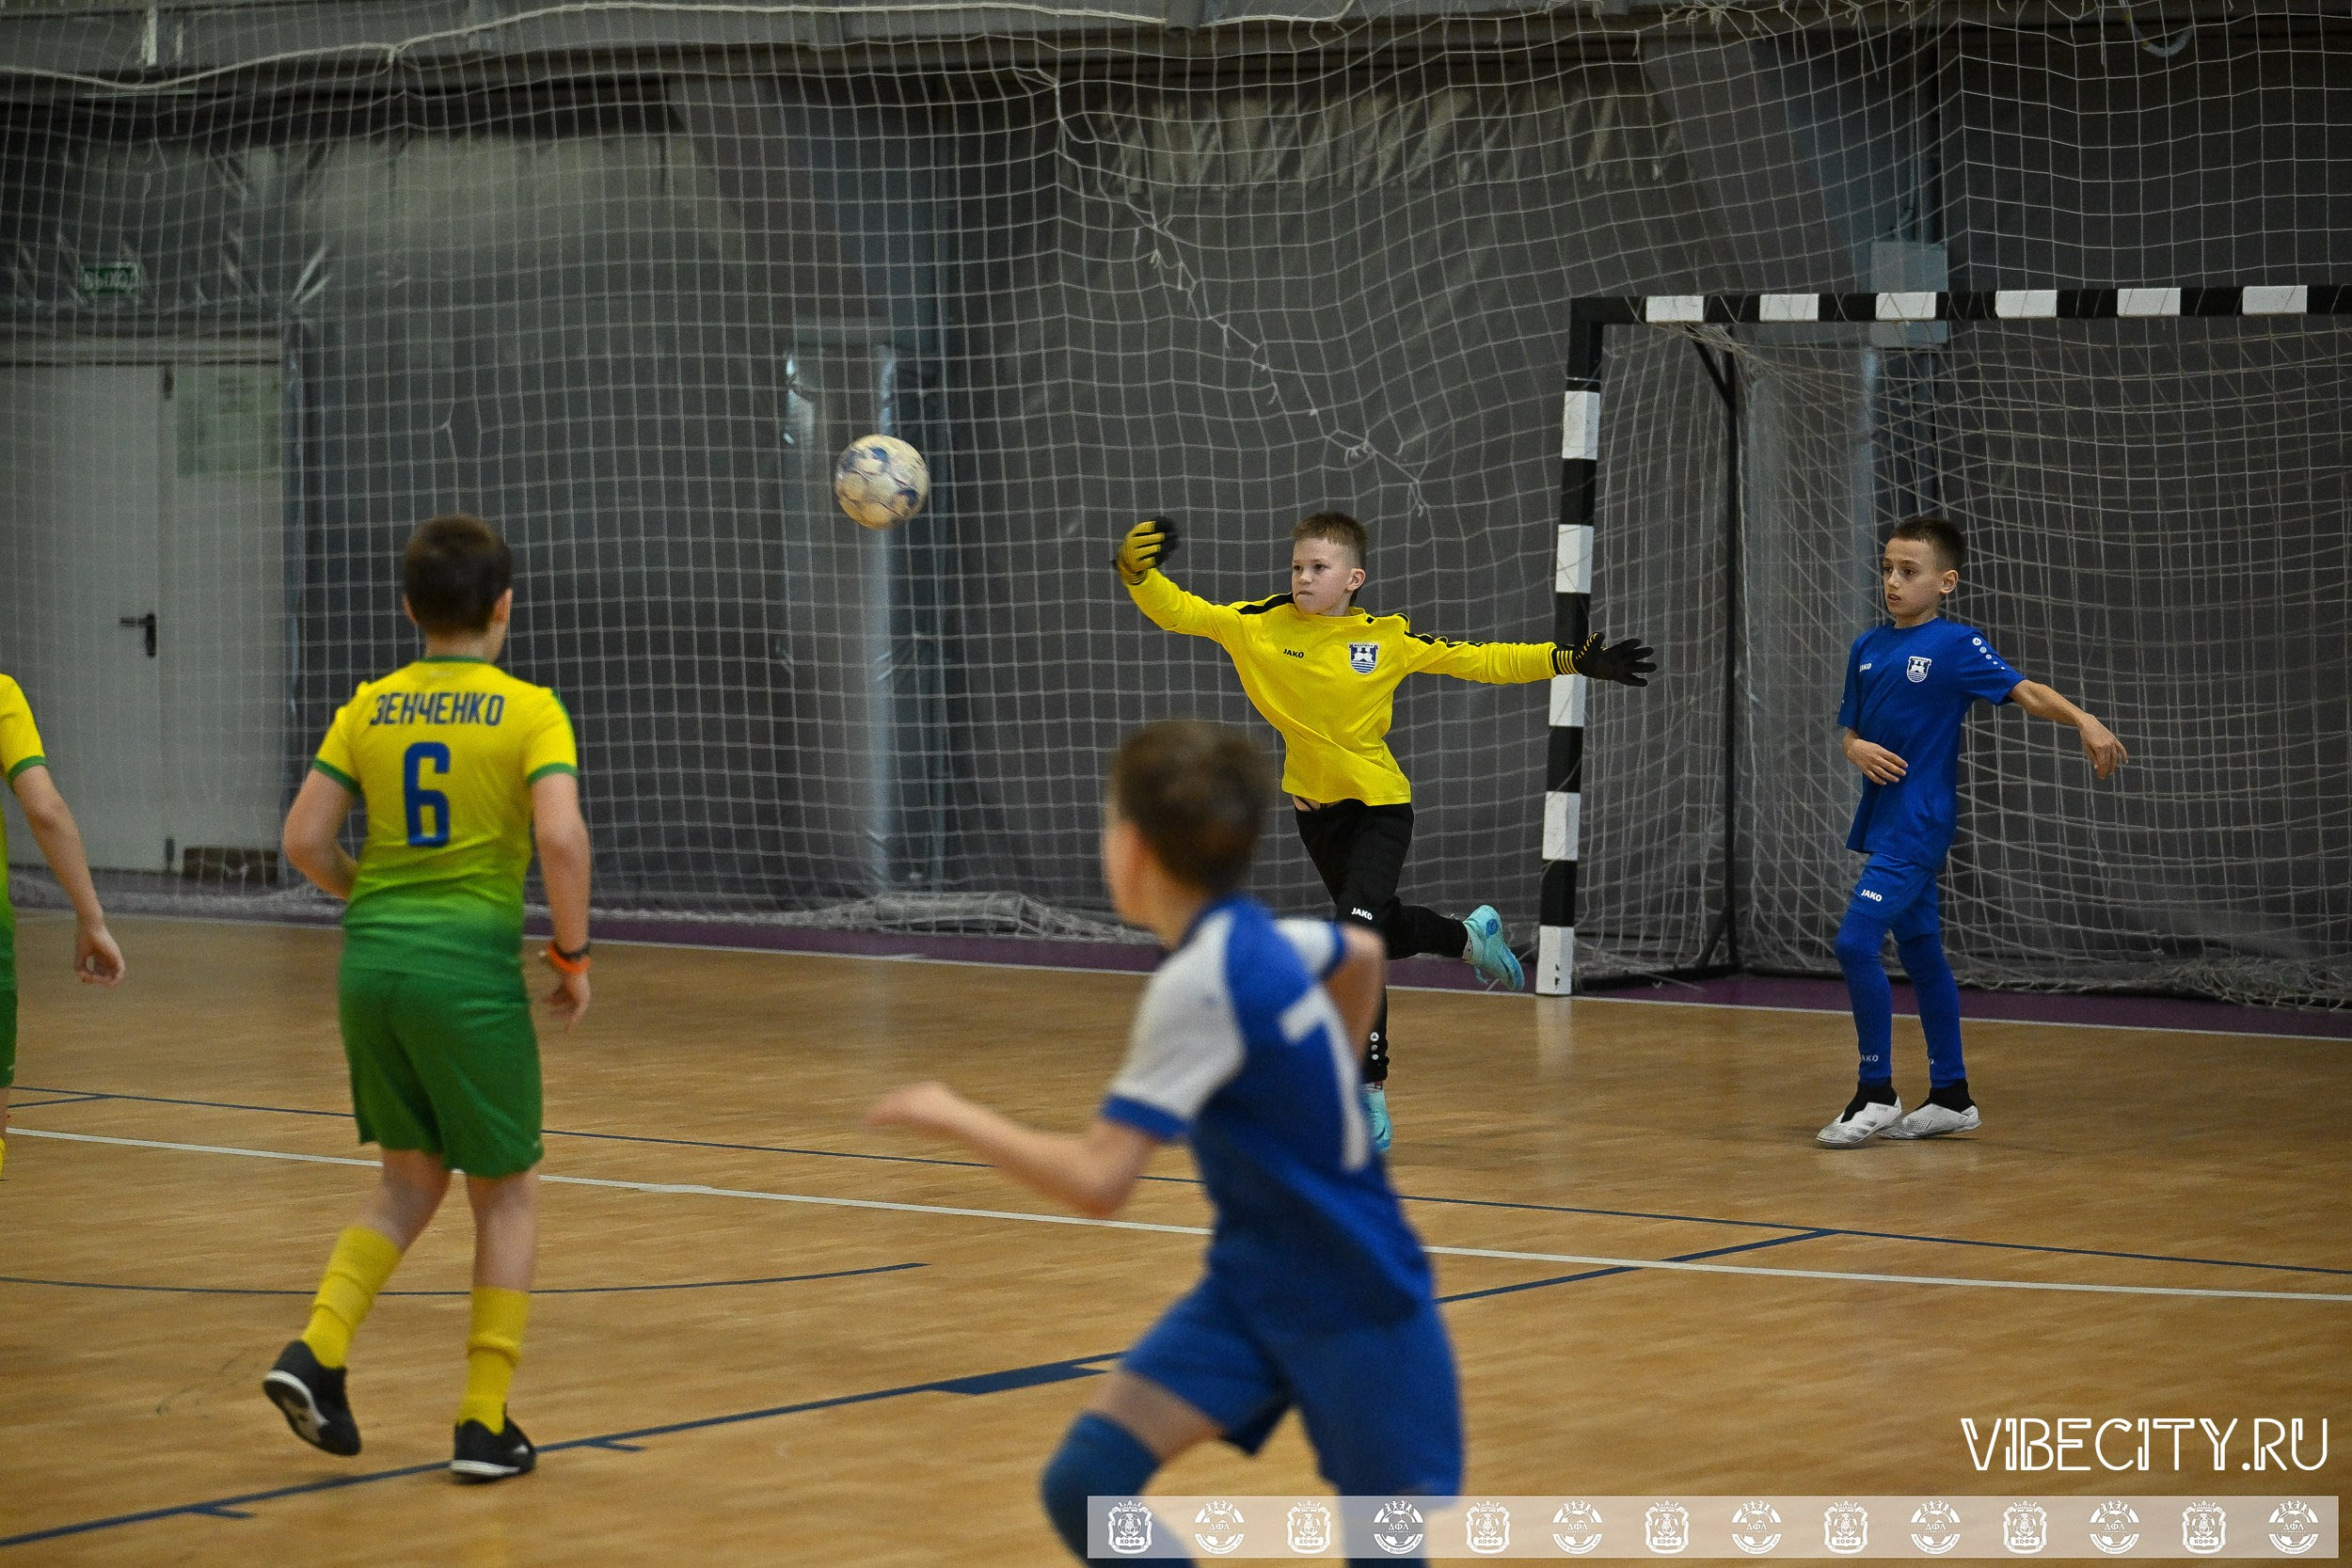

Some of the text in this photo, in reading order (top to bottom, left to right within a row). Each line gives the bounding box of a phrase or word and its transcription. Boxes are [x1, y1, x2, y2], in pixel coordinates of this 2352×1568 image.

[1283, 648, 1305, 658] JAKO
[370, 692, 506, 726] ЗЕНЧЕНКО
[404, 741, 451, 848] 6
[1861, 889, 1883, 902] JAKO
[1351, 908, 1373, 921] JAKO
